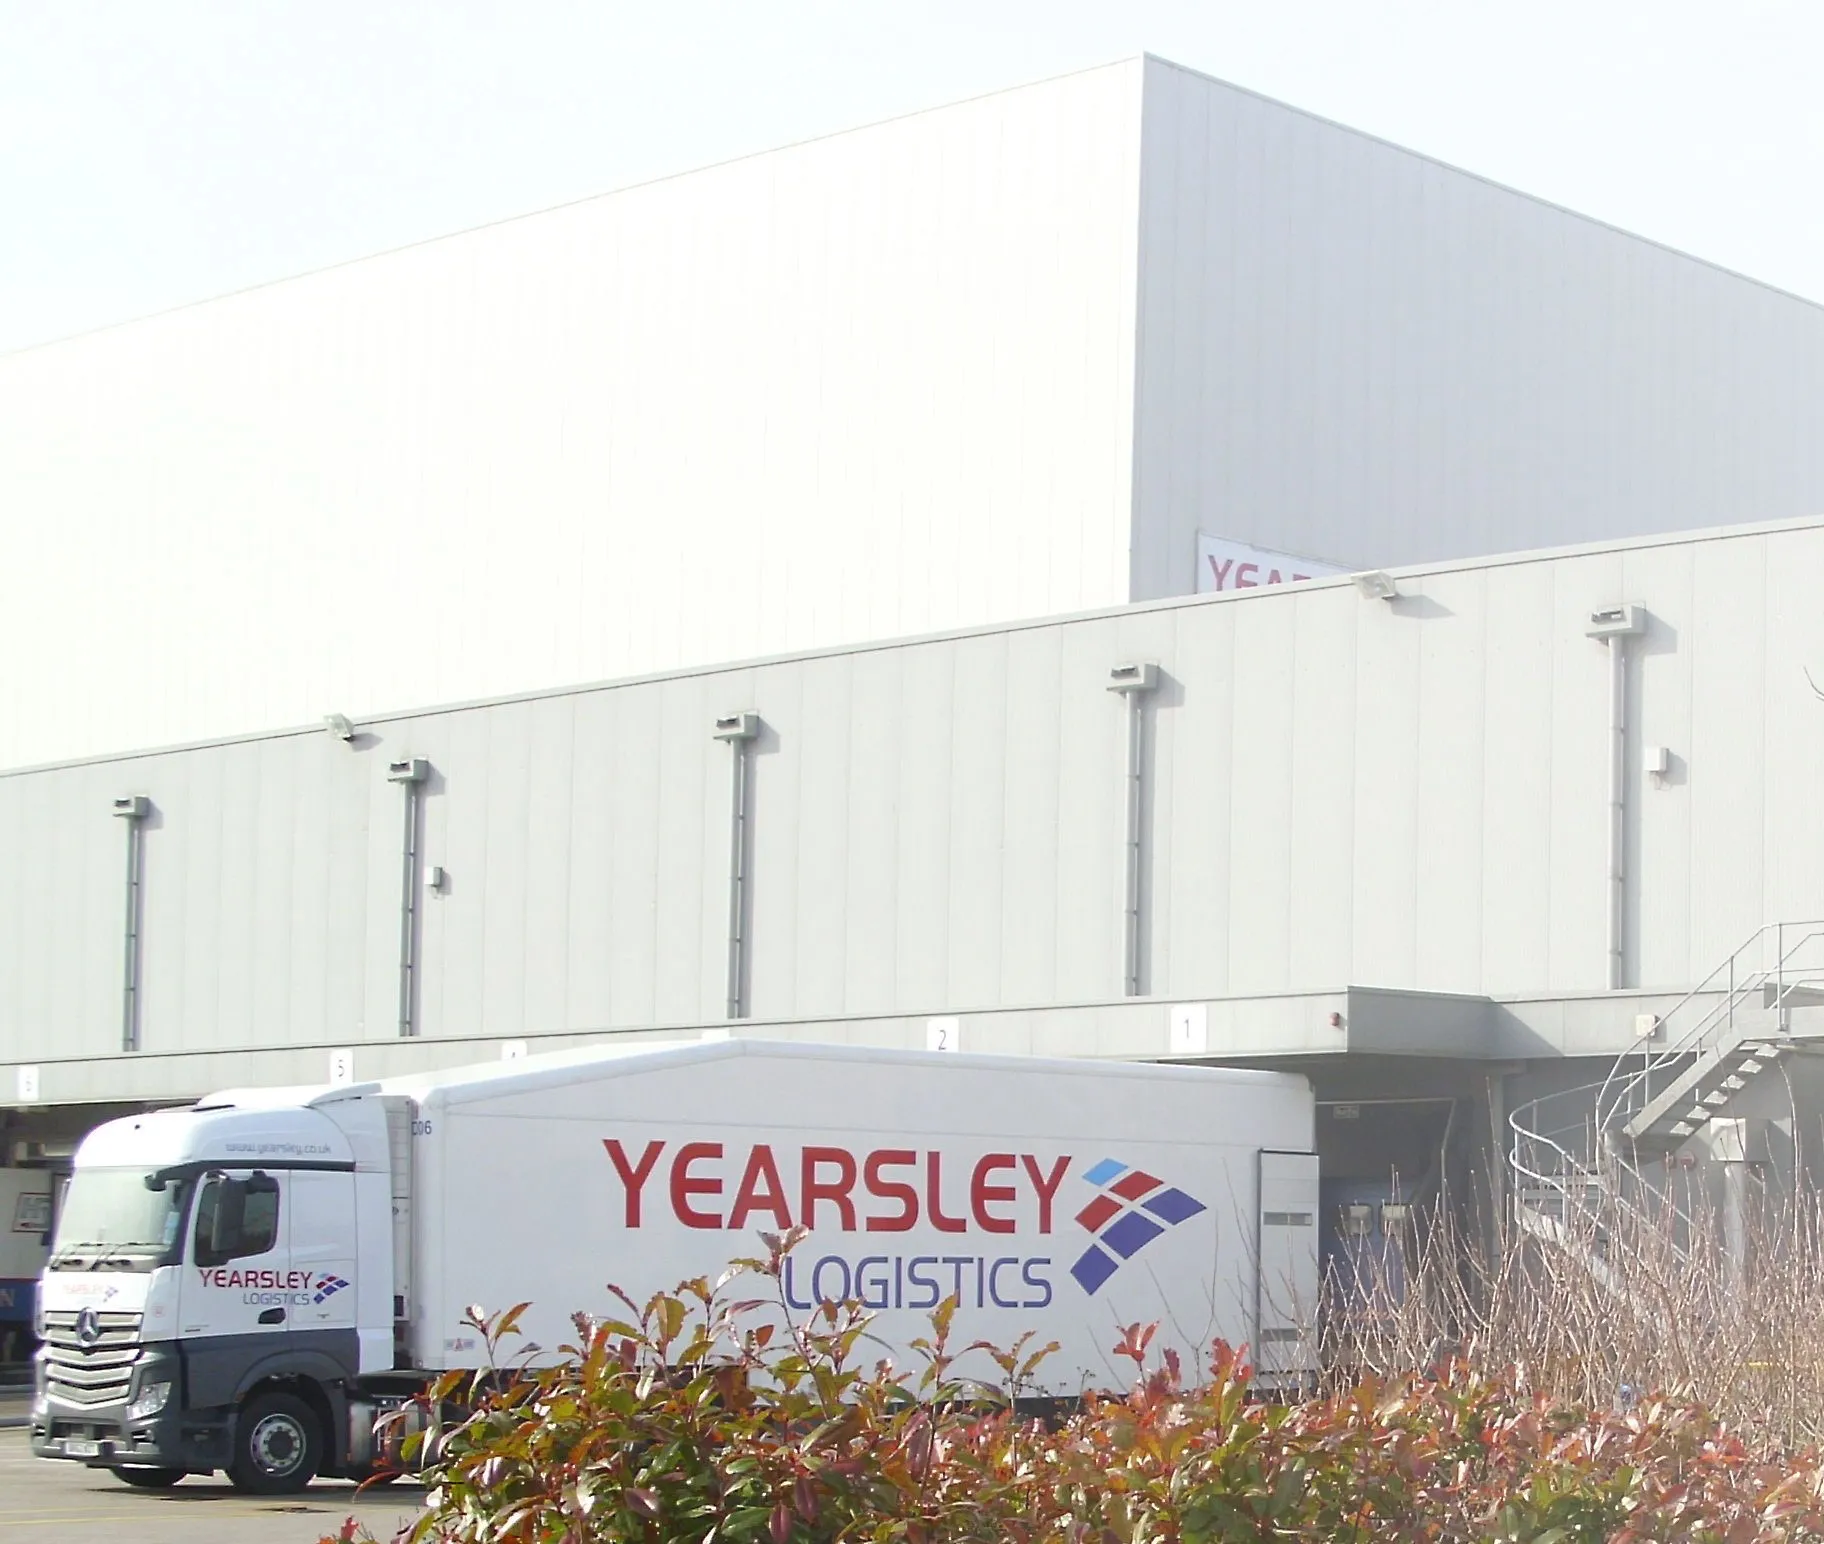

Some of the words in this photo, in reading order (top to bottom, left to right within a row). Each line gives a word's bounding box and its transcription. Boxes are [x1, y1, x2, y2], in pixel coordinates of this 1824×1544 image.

[937, 1029, 947, 1050] 2
[337, 1059, 345, 1078] 5
[604, 1139, 1071, 1234] YEARSLEY
[200, 1269, 313, 1289] YEARSLEY
[784, 1254, 1052, 1309] LOGISTICS
[243, 1292, 310, 1306] LOGISTICS
